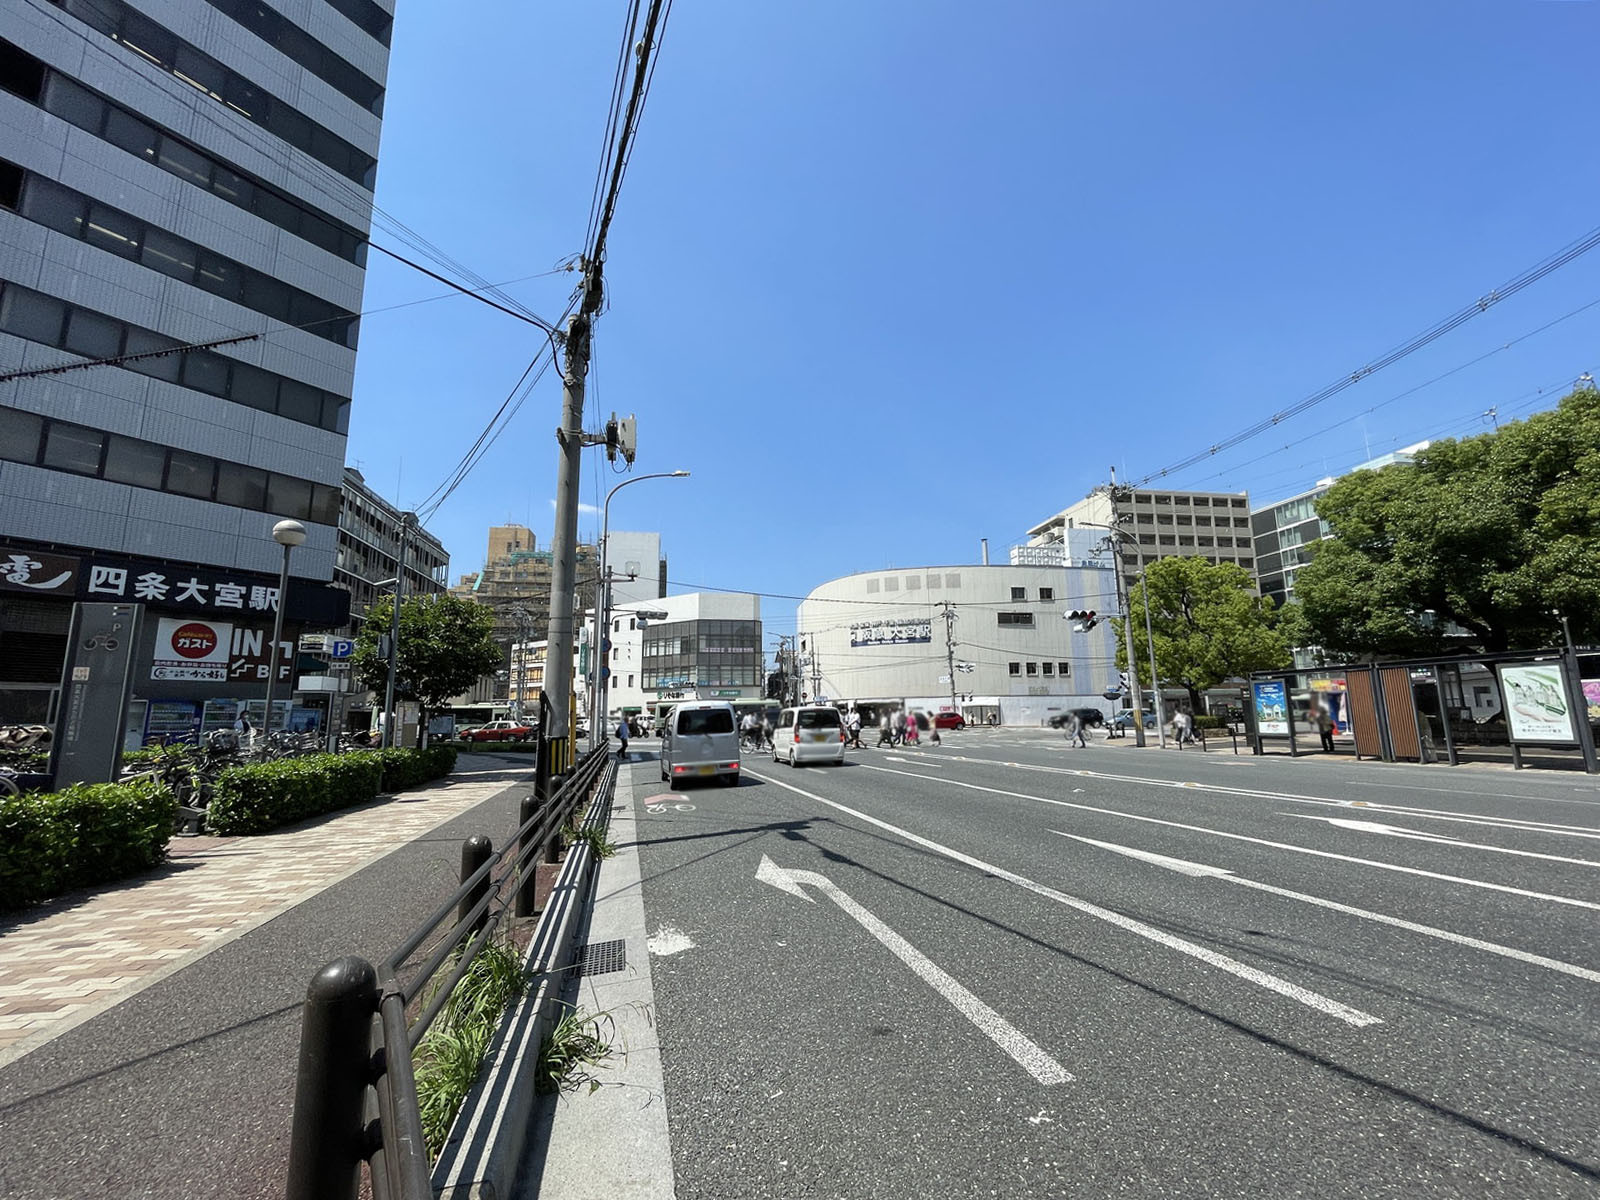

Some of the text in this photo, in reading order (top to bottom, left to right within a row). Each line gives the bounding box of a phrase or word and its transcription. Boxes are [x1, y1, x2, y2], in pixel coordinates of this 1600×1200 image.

[88, 565, 280, 612] 四条大宮駅
[177, 637, 213, 649] ガスト
[232, 628, 263, 657] IN
[337, 643, 349, 656] P
